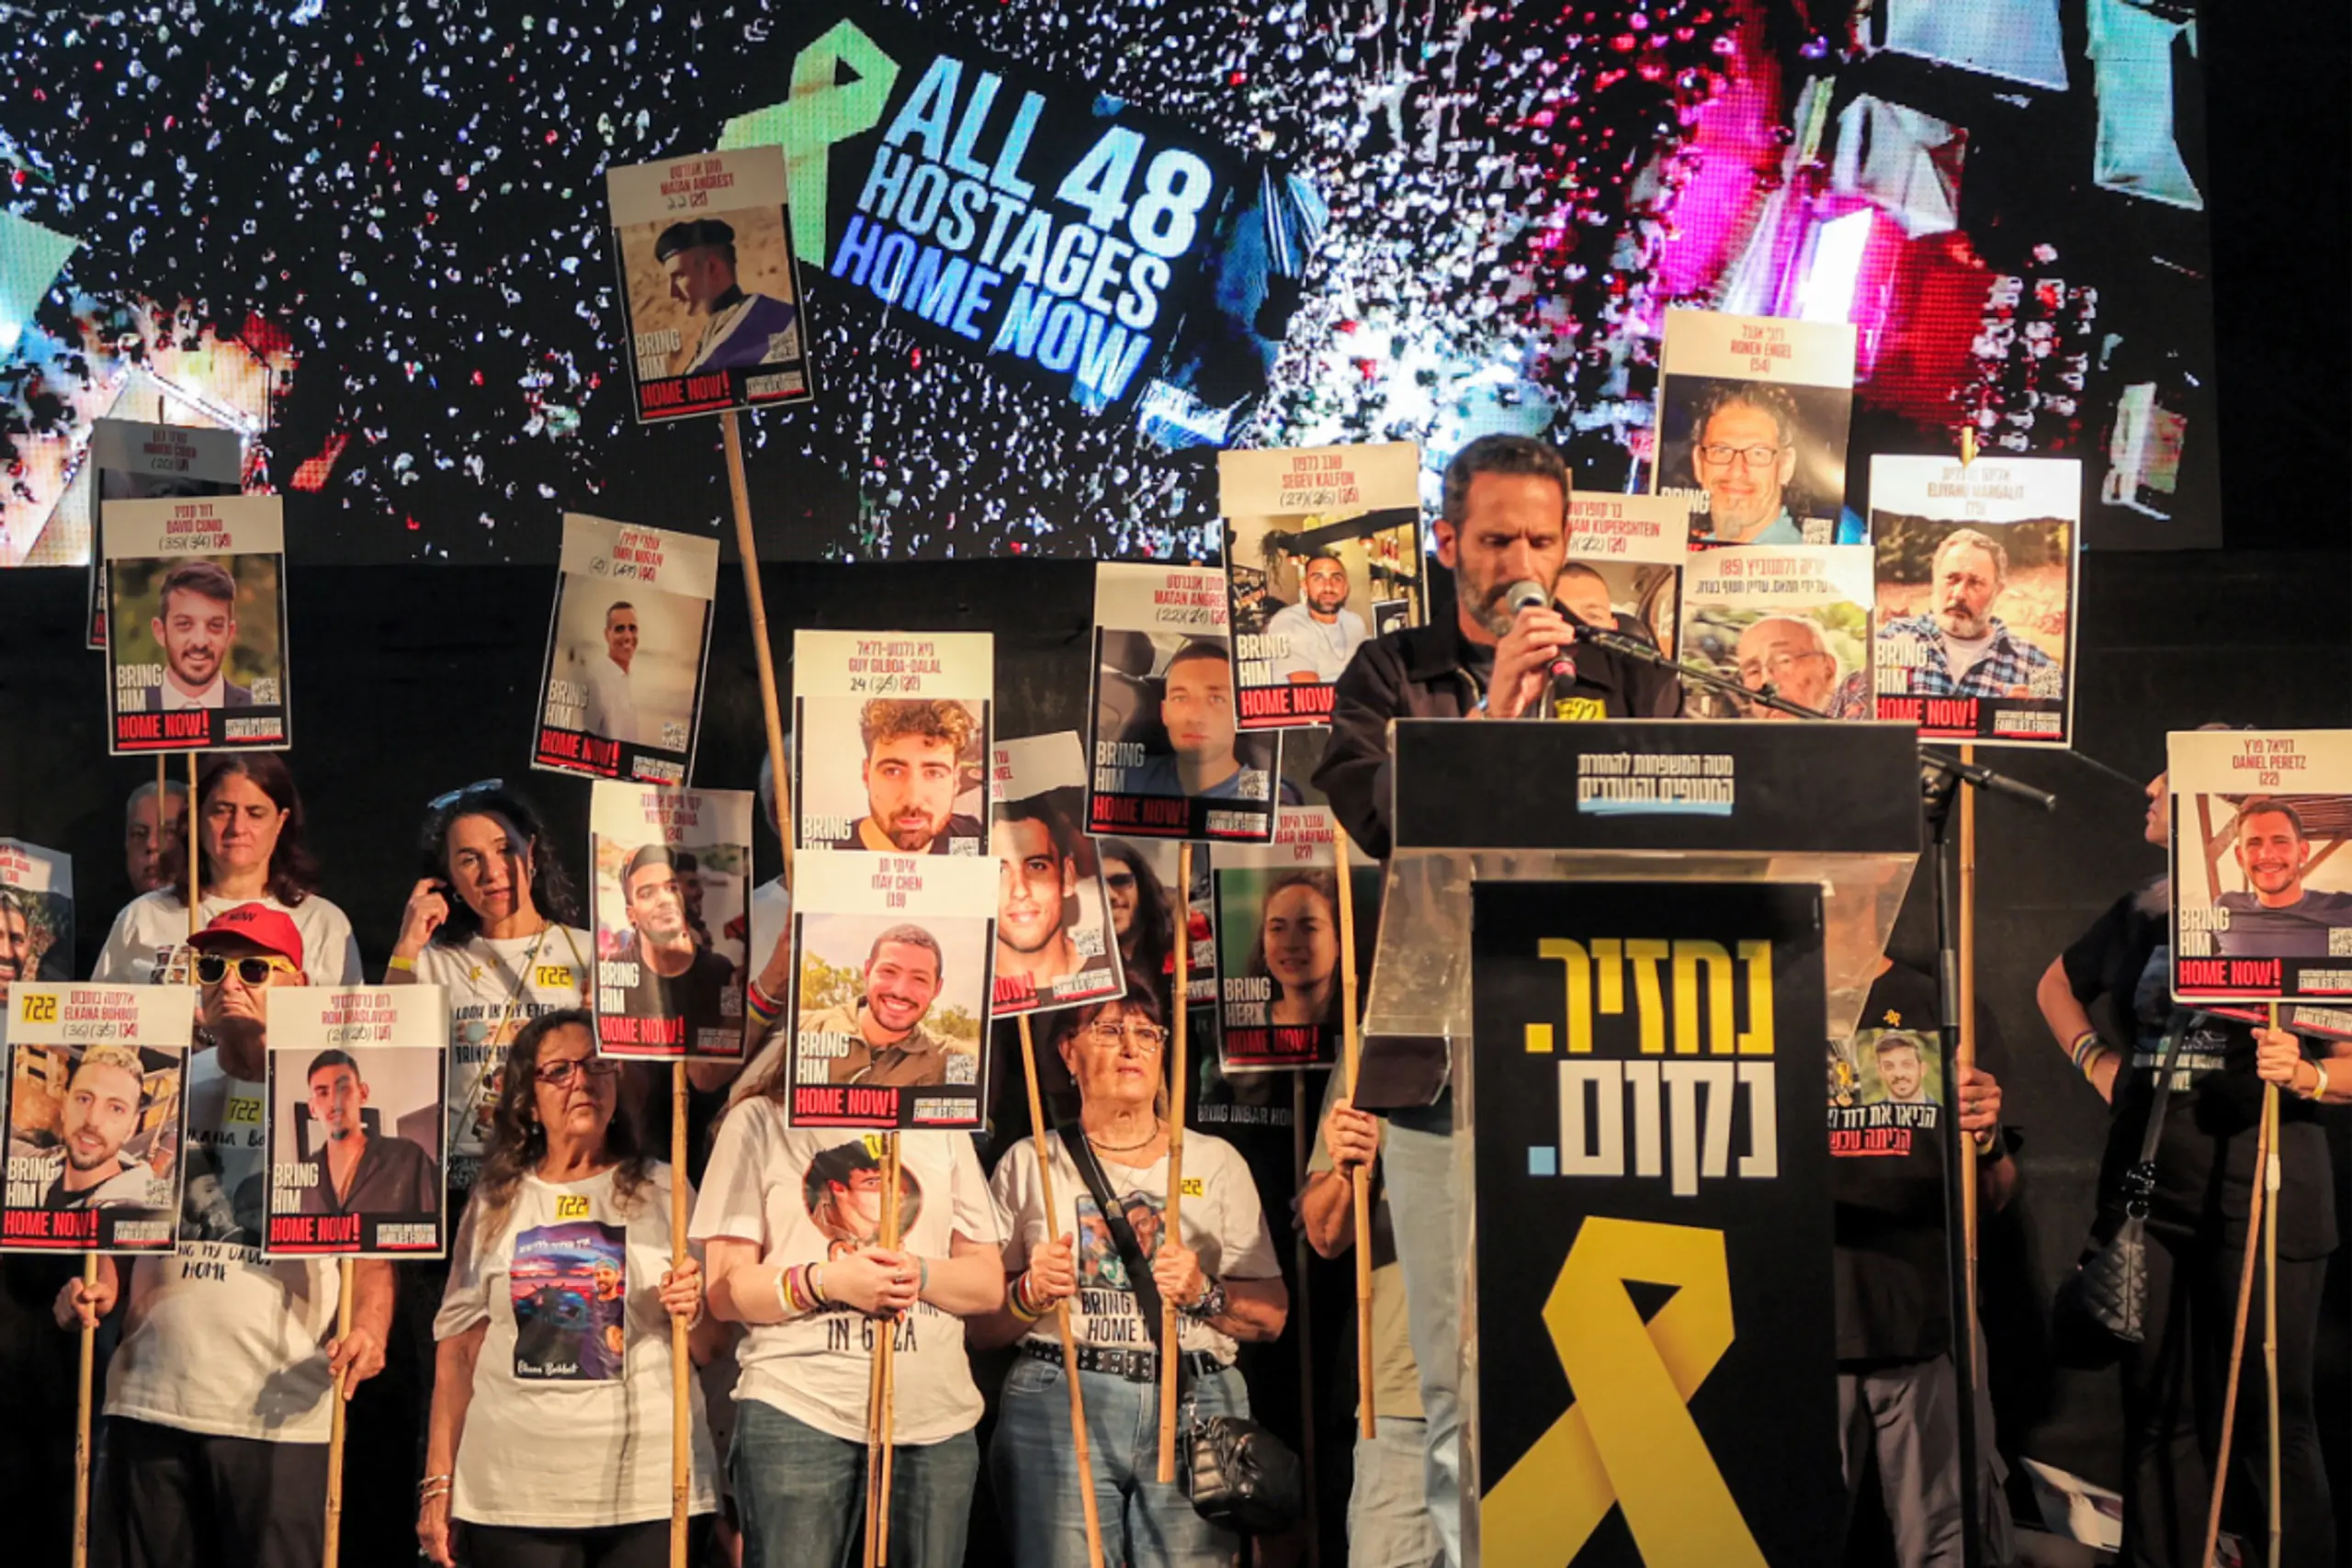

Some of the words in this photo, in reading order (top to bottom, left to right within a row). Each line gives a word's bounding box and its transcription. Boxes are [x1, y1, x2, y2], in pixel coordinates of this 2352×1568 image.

[884, 54, 1046, 202] ALL
[1054, 125, 1212, 258] 48
[661, 180, 691, 195] MATAN
[694, 173, 734, 190] ANGREST
[856, 144, 1170, 330] HOSTAGES
[831, 214, 1001, 341] HOME
[994, 282, 1152, 402] NOW
[636, 328, 680, 356] BRING
[1731, 340, 1762, 355] RONEN
[1764, 344, 1792, 359] ENGEL
[638, 355, 669, 380] HIM
[640, 379, 684, 407] HOME
[688, 370, 730, 400] NOW!
[1283, 474, 1313, 489] SEGEV
[1317, 471, 1355, 487] KALFON
[1972, 484, 2024, 499] MARGALIT
[167, 520, 192, 534] DAVID
[196, 519, 222, 532] CUNIO
[1593, 520, 1660, 536] KUPERSHTEIN
[1720, 558, 1743, 576] (85)
[1155, 591, 1187, 604] MATAN
[1236, 634, 1290, 660] BRING
[1876, 641, 1928, 667] BRING
[118, 664, 163, 687] BRING
[849, 659, 867, 671] GUY
[871, 659, 941, 673] GILBOA-DALAL
[1238, 660, 1272, 686] HIM
[1877, 668, 1907, 694] HIM
[118, 688, 146, 712] HIM
[549, 679, 588, 709] BRING
[1241, 689, 1290, 716] HOME
[1294, 687, 1335, 713] NOW
[118, 714, 161, 739] HOME
[165, 709, 209, 738] NOW!
[544, 702, 572, 729] HIM
[1876, 698, 1923, 723] HOME
[1928, 697, 1978, 727] NOW!
[541, 729, 581, 758] HOME
[582, 739, 620, 767] NOW!
[1096, 741, 1146, 767] BRING
[1577, 751, 1631, 775] להחזרת
[1633, 754, 1700, 775] המשפחות
[1703, 755, 1734, 775] מטה
[2233, 755, 2267, 769] DANIEL
[2270, 755, 2306, 769] PERETZ
[1095, 768, 1125, 793] HIM
[1577, 777, 1657, 804] והנעדרים
[1660, 777, 1735, 804] החטופים
[2259, 772, 2279, 786] (22)
[1093, 795, 1137, 823] HOME
[1143, 797, 1190, 826] NOW!
[802, 816, 852, 840] BRING
[1298, 829, 1334, 843] HAYMA
[1294, 845, 1312, 860] (27)
[872, 876, 893, 889] ITAY
[896, 876, 922, 891] CHEN
[887, 893, 906, 908] (19)
[2181, 908, 2230, 931] BRING
[2180, 931, 2211, 956] HIM
[537, 965, 571, 985] 722
[599, 962, 639, 987] BRING
[2179, 961, 2227, 985] HOME
[2231, 958, 2281, 987] NOW!
[600, 987, 625, 1014] HIM
[1225, 976, 1272, 1002] BRING
[1524, 937, 1774, 1054] נחזיר.
[23, 996, 56, 1021] 722
[64, 1007, 98, 1021] ELKANA
[102, 1007, 139, 1021] BOHBOT
[322, 1011, 341, 1024] ROM
[345, 1010, 397, 1024] BRASLAVSKI
[457, 1007, 484, 1020] LOOK
[1226, 1003, 1255, 1026] HER
[600, 1017, 639, 1042] HOME
[641, 1015, 684, 1043] NOW!
[1227, 1029, 1269, 1053] HOME
[1274, 1025, 1318, 1053] NOW!
[797, 1032, 850, 1056] BRING
[797, 1058, 829, 1084] HIM
[230, 1099, 261, 1121] 722
[795, 1088, 843, 1114] HOME
[848, 1088, 899, 1117] NOW!
[1198, 1104, 1227, 1122] BRING
[1231, 1105, 1268, 1124] INBAR
[1528, 1060, 1778, 1196] נקום.
[1841, 1107, 1867, 1126] דוד
[1869, 1105, 1892, 1126] את
[1895, 1105, 1938, 1129] הביאו
[1864, 1128, 1911, 1150] הביתה
[7, 1156, 56, 1181] BRING
[274, 1162, 319, 1187] BRING
[6, 1182, 37, 1207] HIM
[1182, 1179, 1202, 1195] 22
[273, 1188, 301, 1213] HIM
[558, 1196, 588, 1216] 722
[4, 1211, 49, 1235] HOME
[53, 1209, 98, 1236] NOW!
[271, 1217, 314, 1242] HOME
[318, 1213, 360, 1241] NOW!
[182, 1261, 227, 1281] HOME
[1081, 1292, 1131, 1314] BRING
[828, 1318, 850, 1350] IN
[861, 1318, 917, 1352] GZA
[1088, 1318, 1137, 1342] HOME
